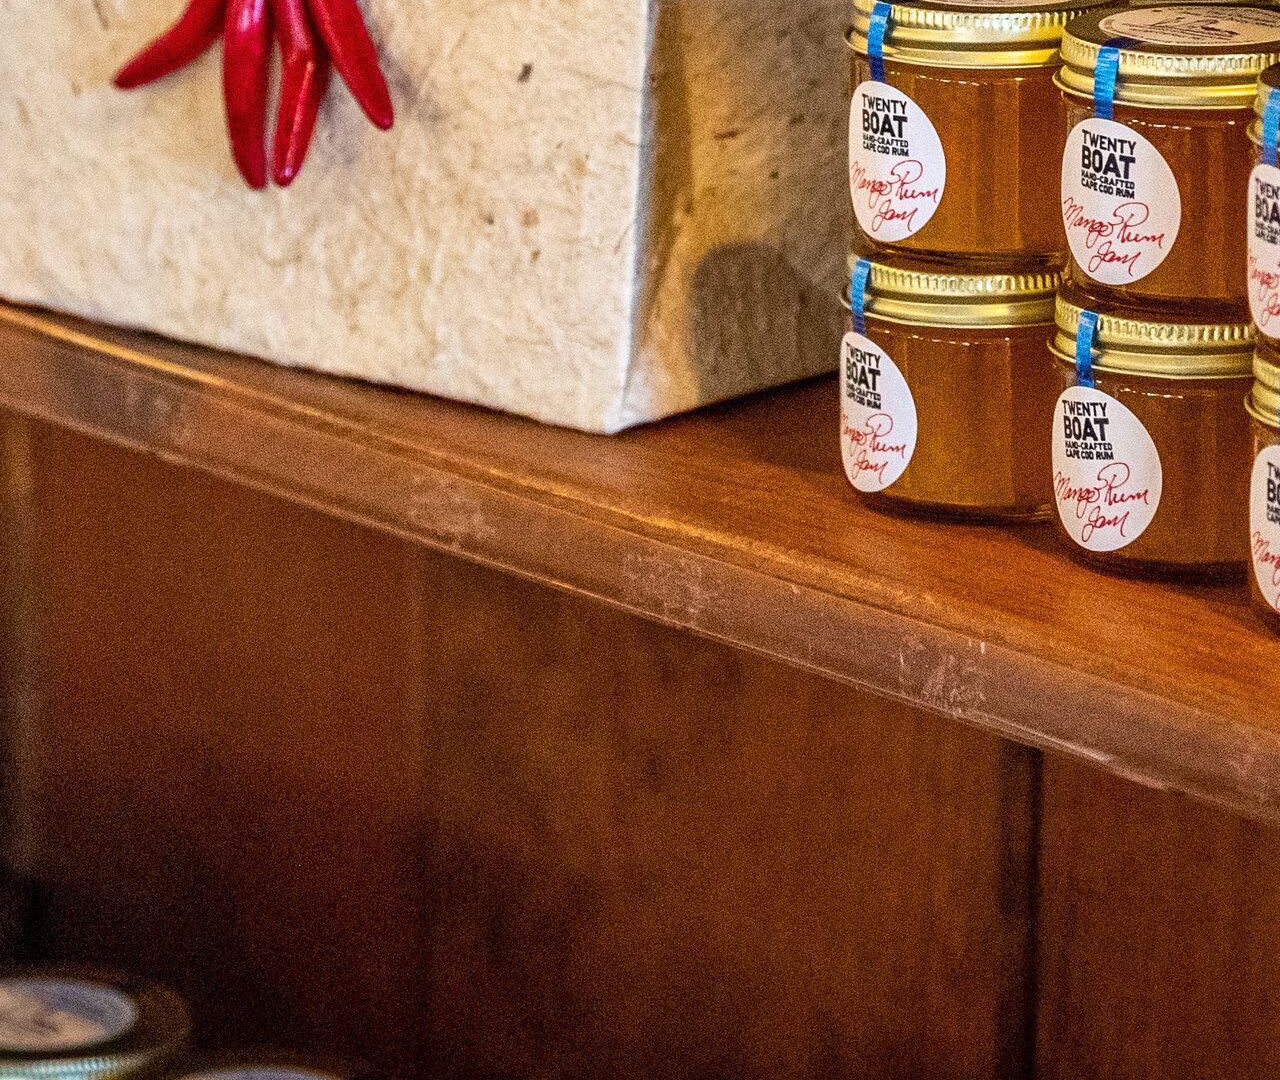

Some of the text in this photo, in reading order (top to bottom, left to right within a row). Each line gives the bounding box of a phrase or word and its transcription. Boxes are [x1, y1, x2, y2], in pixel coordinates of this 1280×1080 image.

[862, 94, 907, 115] TWENTY
[862, 109, 908, 138] BOAT
[863, 133, 909, 148] HAND-CRAFTED
[863, 142, 909, 157] CAPE COD RUM
[1081, 129, 1136, 155] TWENTY
[1081, 145, 1136, 179] BOAT
[850, 159, 939, 209] Mango Rum
[1081, 169, 1135, 190] HAND-CRAFTED
[1081, 178, 1135, 199] CAPE COD RUM
[872, 199, 918, 232] Jam
[1063, 197, 1164, 249] Mango Rum
[1088, 241, 1141, 277] Jam
[846, 341, 881, 369] TWENTY
[846, 357, 881, 391] BOAT
[1062, 400, 1107, 417] TWENTY
[1063, 415, 1109, 441] BOAT
[1065, 441, 1113, 451] HAND-CRAFTED
[1066, 449, 1114, 460] CAPE COD RUM
[852, 450, 888, 484] Jam
[1054, 462, 1149, 519] Mango Rum
[1082, 505, 1130, 543] Jam
